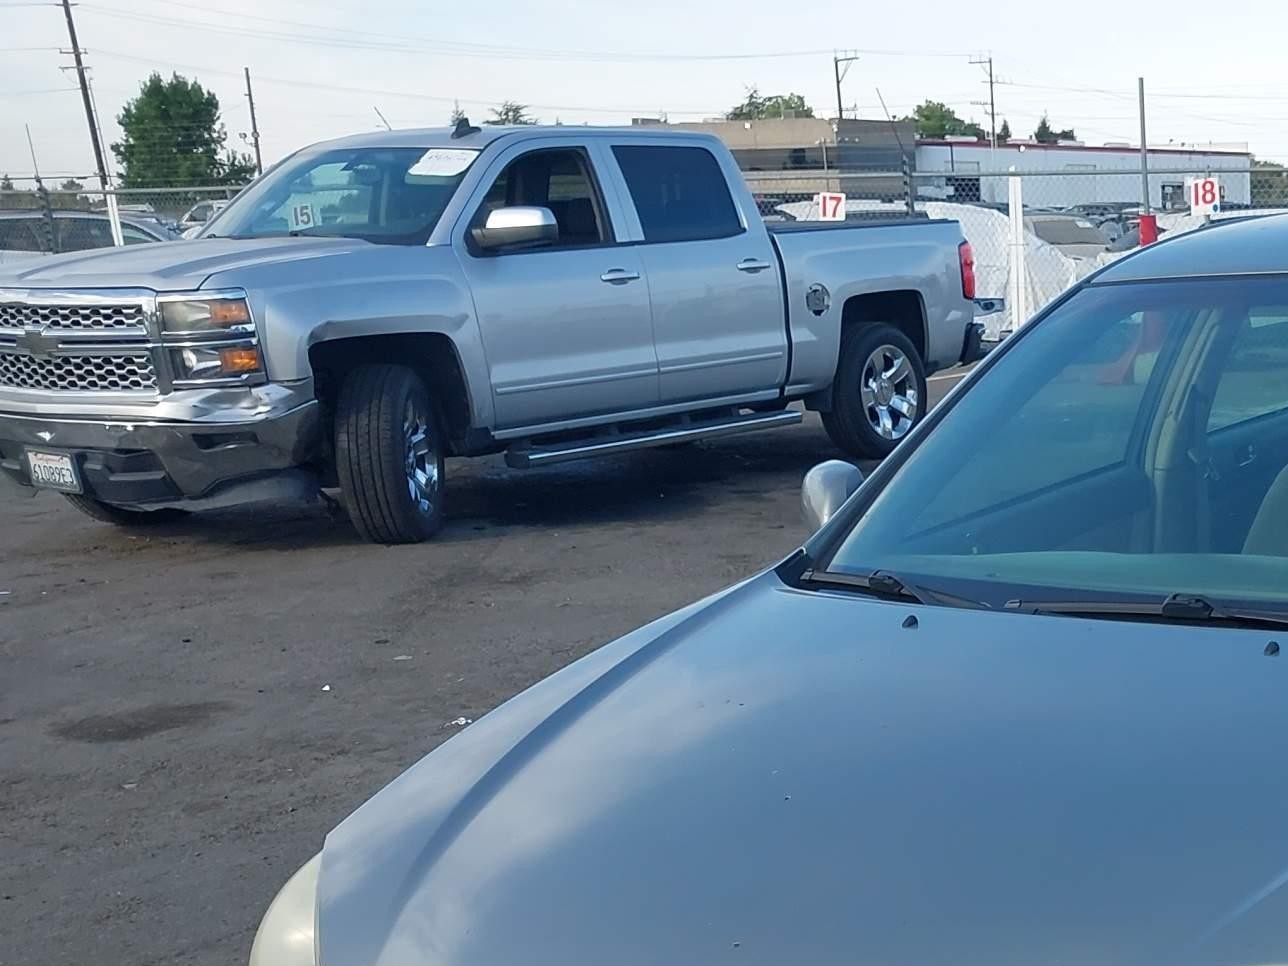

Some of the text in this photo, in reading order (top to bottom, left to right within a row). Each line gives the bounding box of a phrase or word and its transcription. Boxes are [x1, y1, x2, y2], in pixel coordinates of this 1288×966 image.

[1194, 180, 1216, 206] 18
[293, 205, 311, 226] 15
[822, 195, 842, 217] 17
